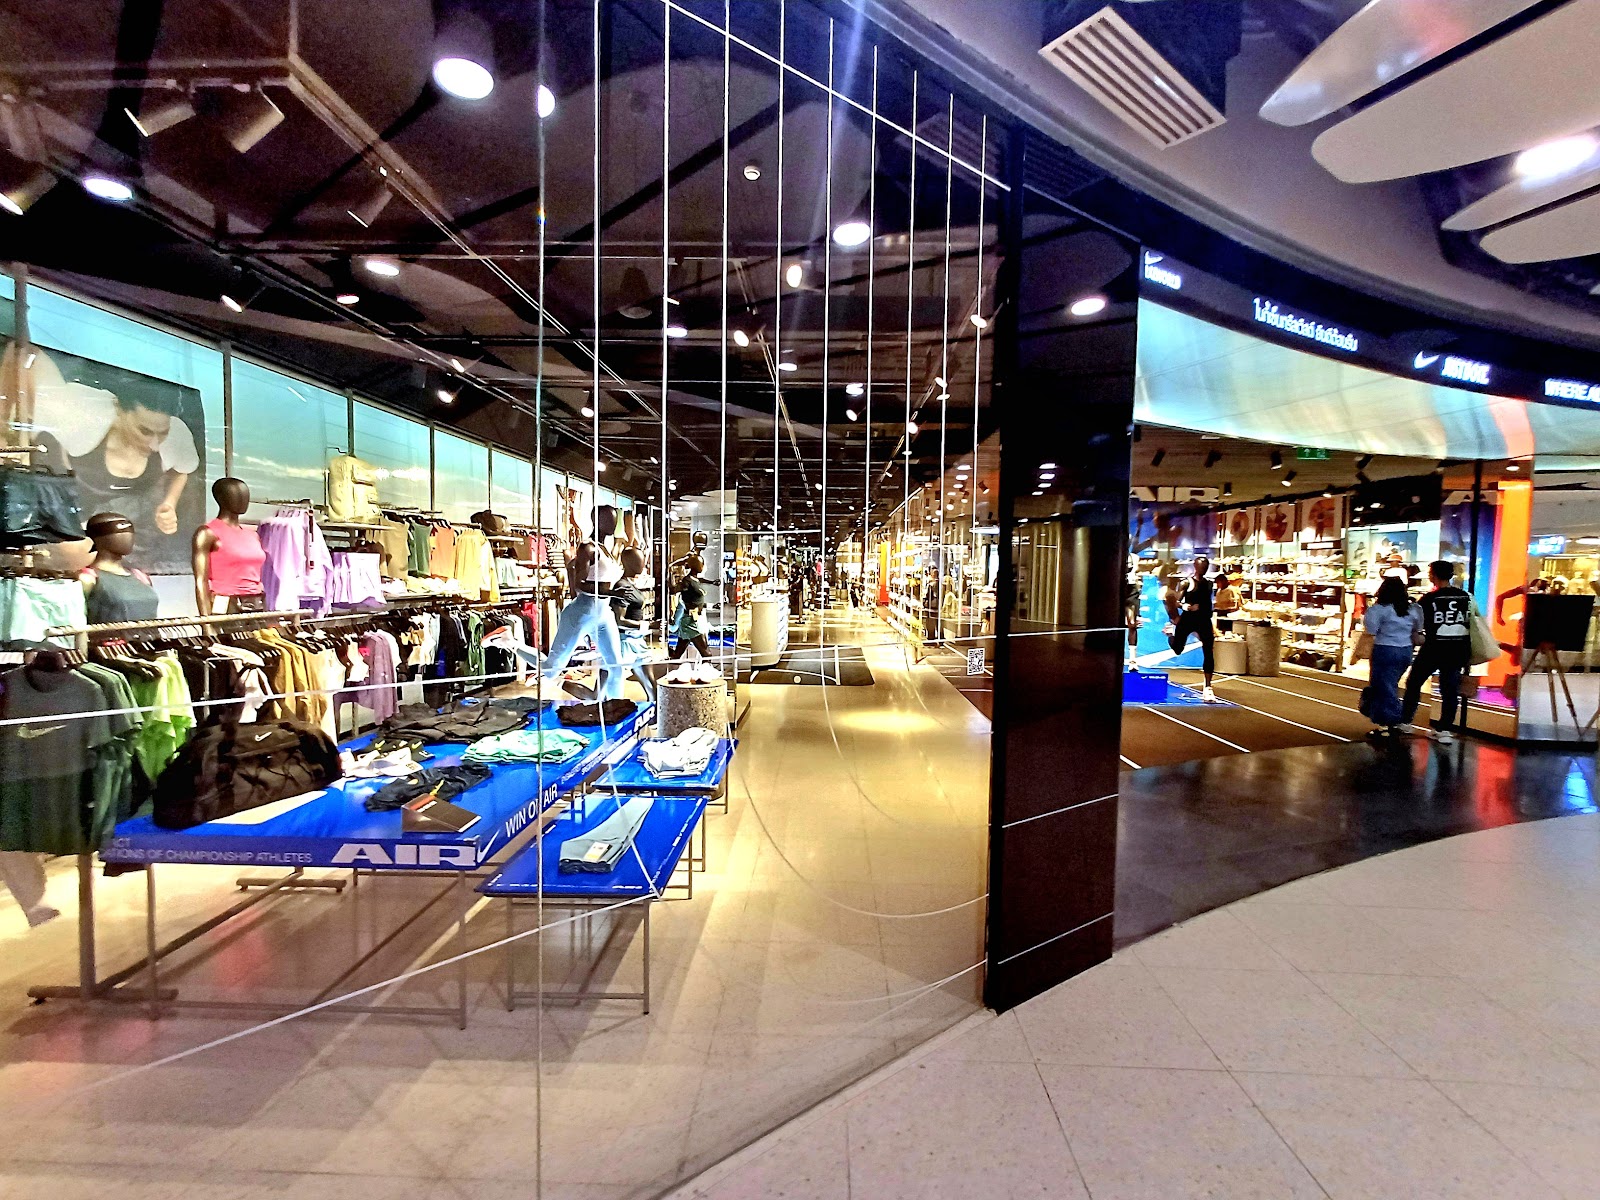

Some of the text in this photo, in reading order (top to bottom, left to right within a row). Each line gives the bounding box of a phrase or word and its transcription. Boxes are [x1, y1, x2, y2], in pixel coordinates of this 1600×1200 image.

[1545, 378, 1587, 401] WHERE
[505, 807, 526, 838] WIN
[543, 783, 558, 808] AIR
[146, 848, 163, 860] OF
[166, 849, 254, 862] CHAMPIONSHIP
[256, 851, 313, 864] ATHLETES
[330, 843, 477, 867] AIR
